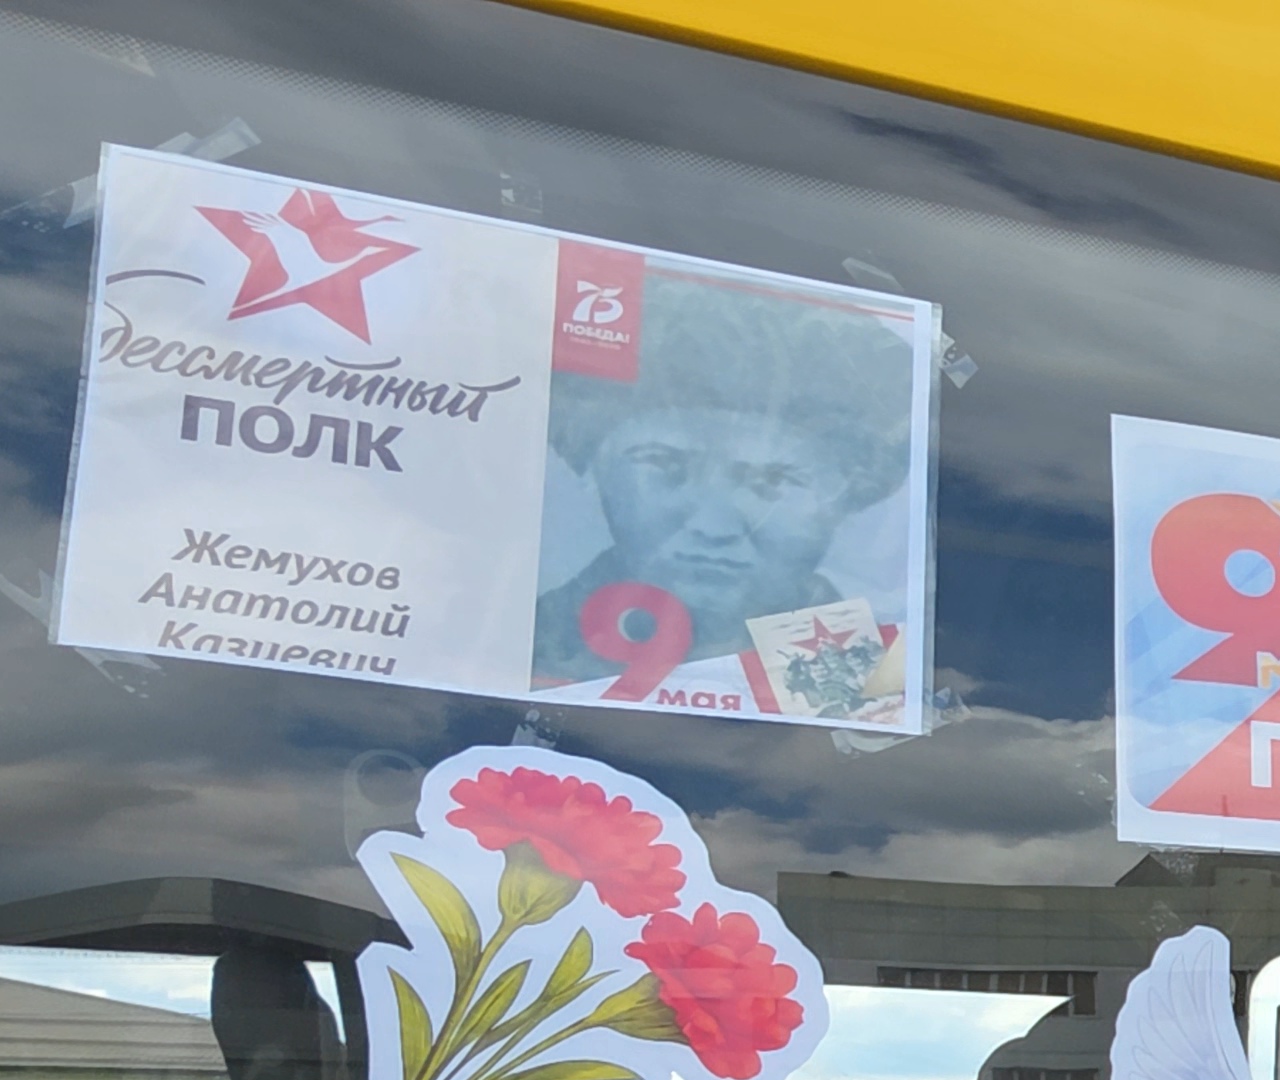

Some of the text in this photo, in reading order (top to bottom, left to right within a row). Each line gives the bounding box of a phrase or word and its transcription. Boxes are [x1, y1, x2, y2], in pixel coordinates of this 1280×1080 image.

[572, 280, 624, 324] 75
[180, 394, 405, 473] ПОЛК
[171, 528, 400, 591] Жемухов
[137, 571, 411, 639] Анатолий
[579, 581, 742, 712] 9 мая
